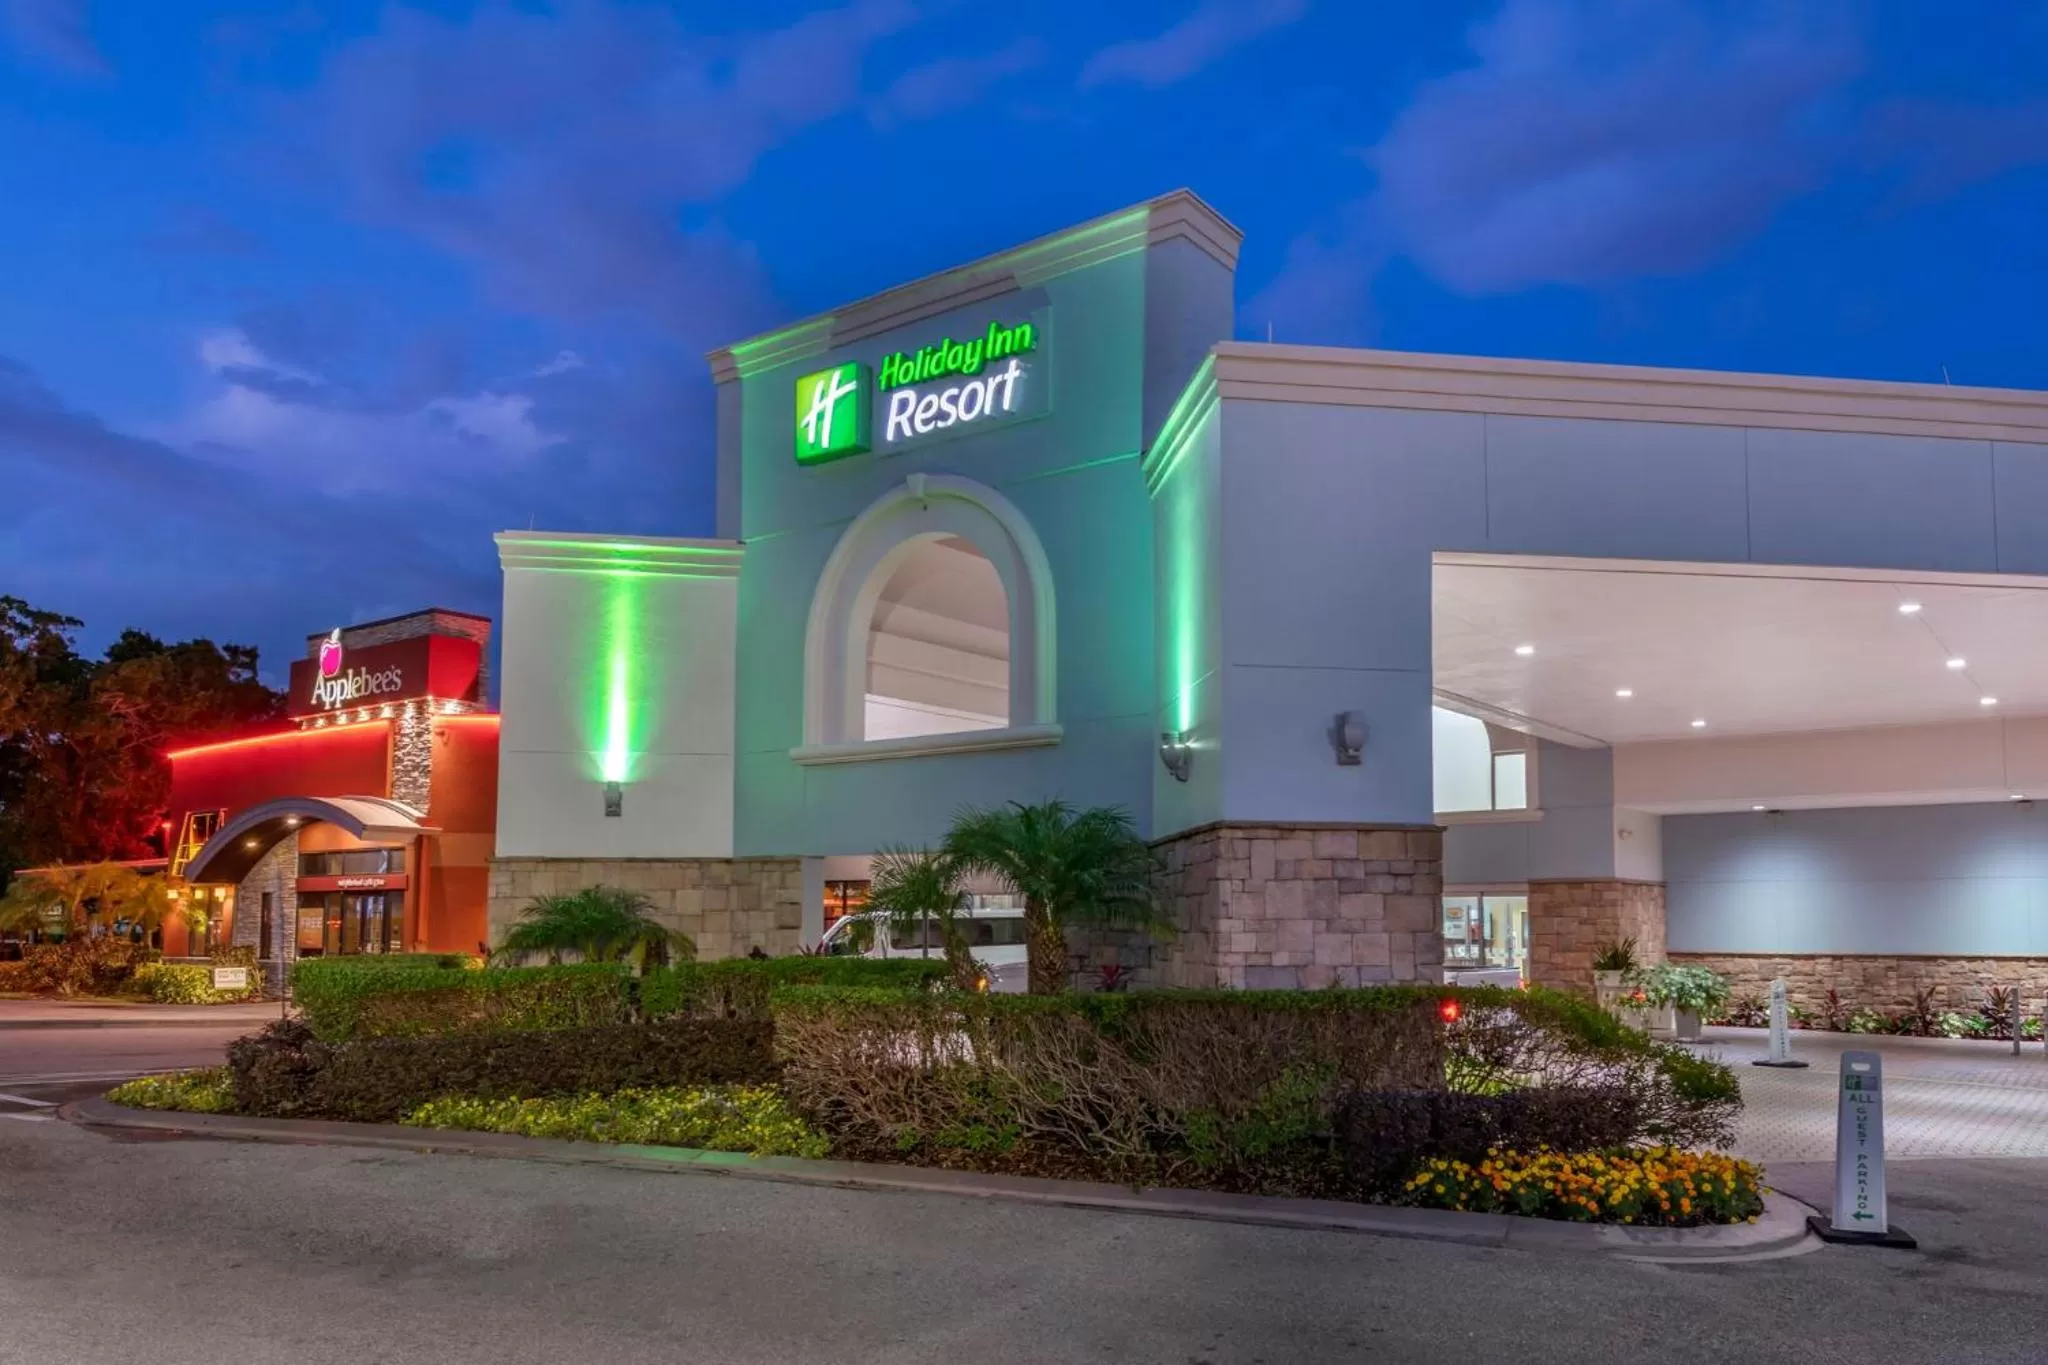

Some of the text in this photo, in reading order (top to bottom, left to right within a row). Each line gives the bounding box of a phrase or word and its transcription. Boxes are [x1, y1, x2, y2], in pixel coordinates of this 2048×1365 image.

[879, 320, 1035, 391] Holiday Inn
[886, 359, 1022, 441] Resort
[310, 665, 402, 710] Applebee's
[1848, 1093, 1875, 1104] ALL
[1855, 1107, 1869, 1209] GUEST PARKING
